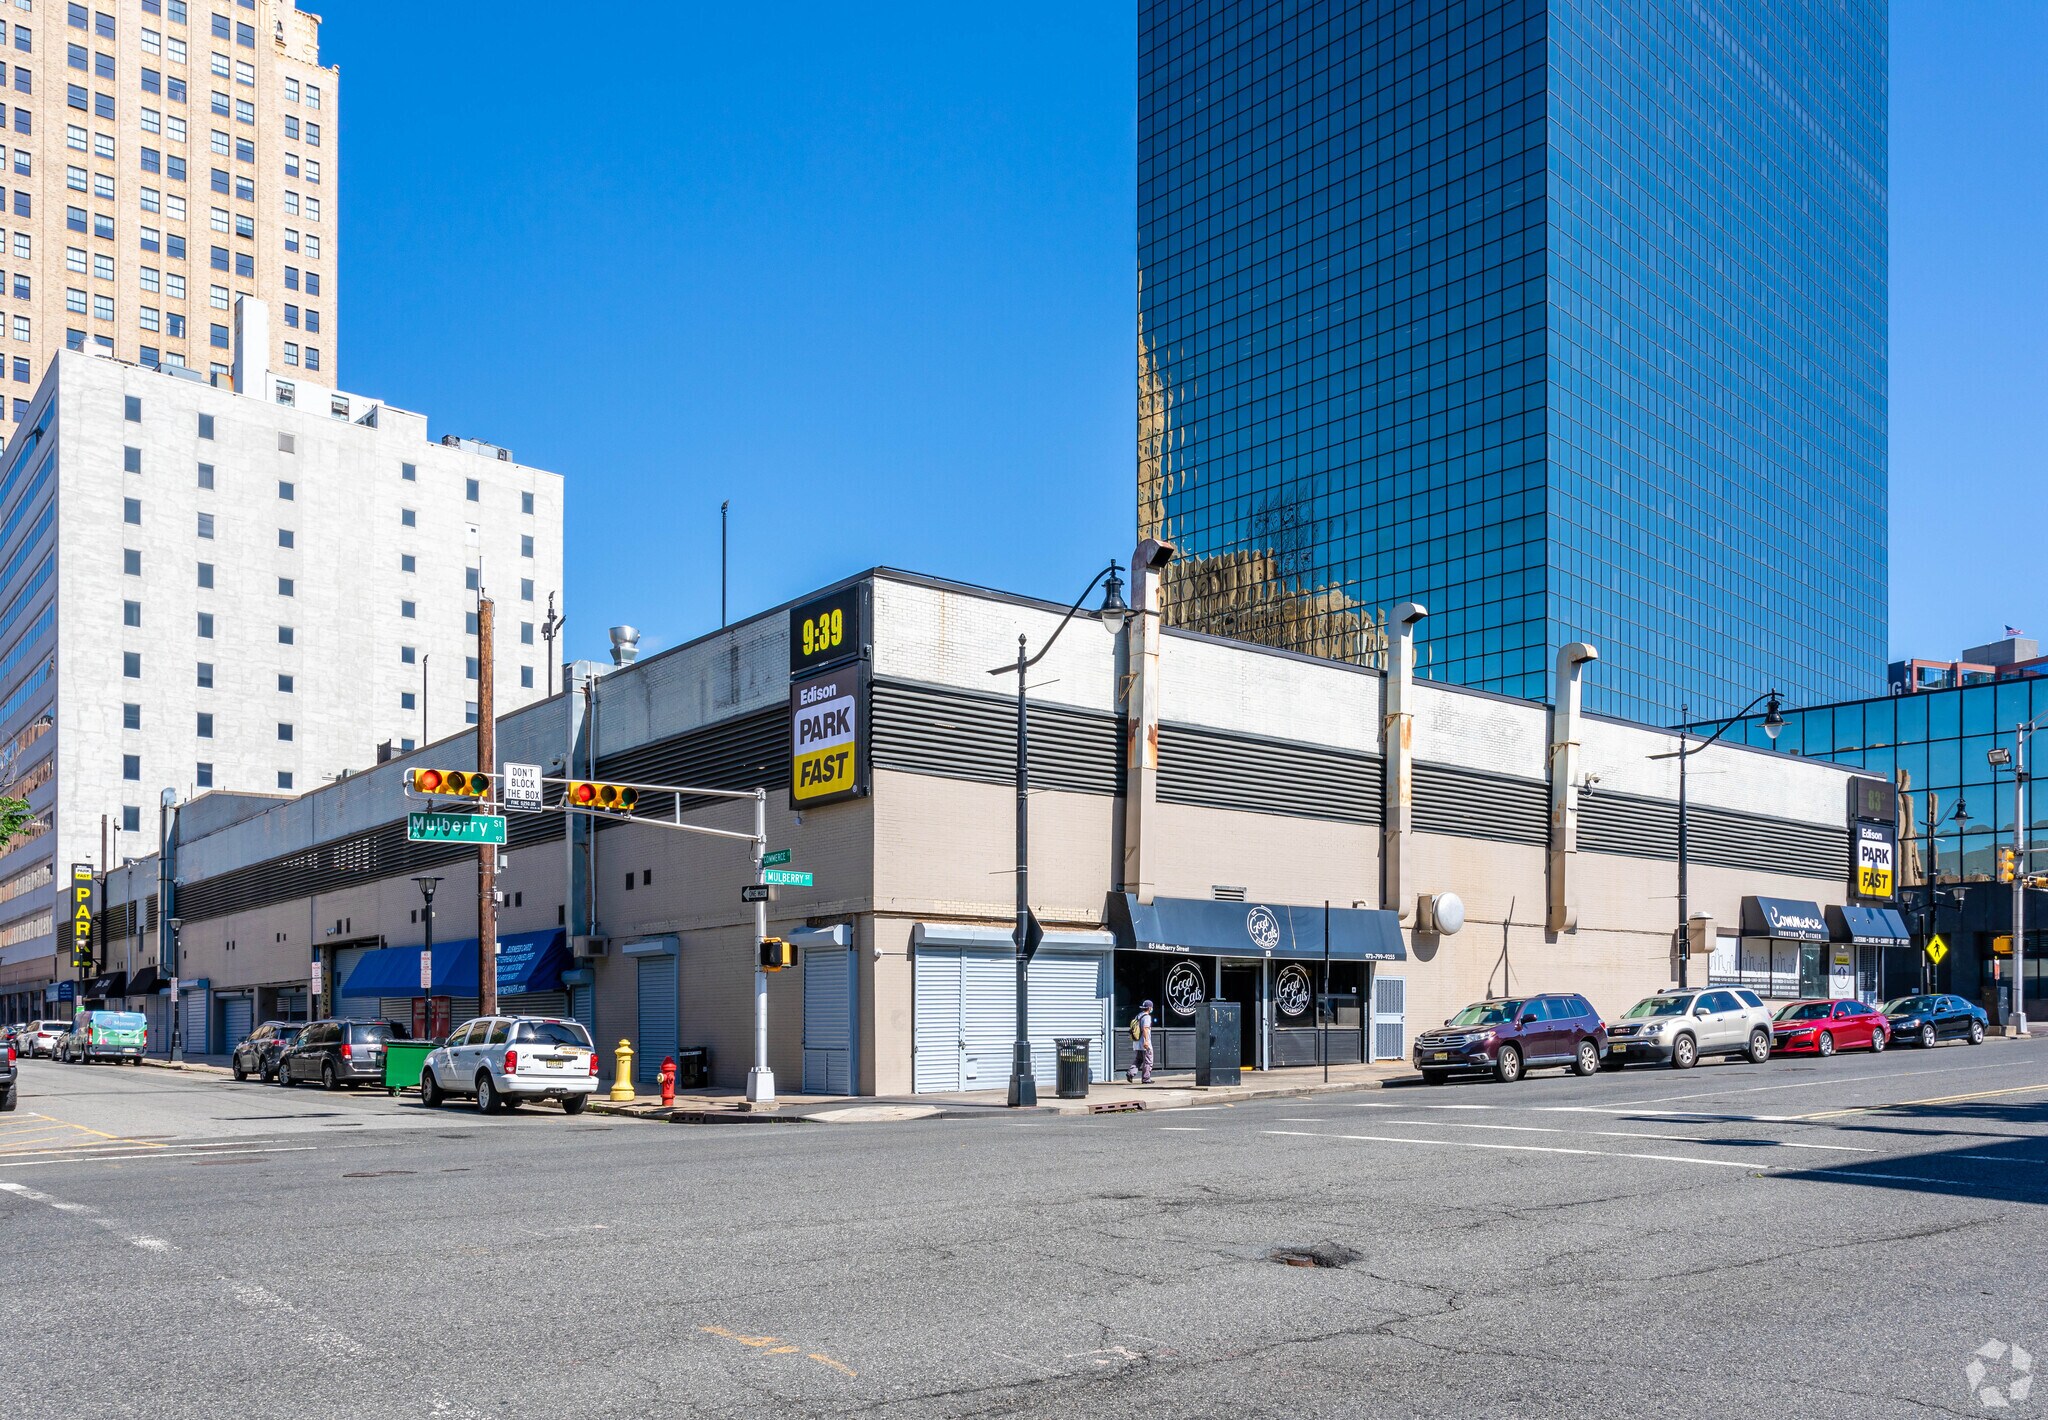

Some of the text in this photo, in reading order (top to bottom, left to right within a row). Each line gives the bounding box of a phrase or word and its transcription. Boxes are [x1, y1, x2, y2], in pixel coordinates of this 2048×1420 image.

[803, 608, 843, 656] 9:39
[800, 683, 837, 706] Edison
[800, 706, 851, 745] PARK
[512, 767, 533, 777] DON'T
[800, 751, 849, 788] FAST
[511, 778, 535, 788] BLOCK
[507, 789, 540, 800] THE BOX
[412, 815, 502, 837] Mulberry St
[1861, 828, 1882, 840] Edison
[764, 852, 786, 864] COMMERCE
[1862, 846, 1889, 864] PARK
[768, 872, 804, 884] MULBERRY
[1863, 872, 1888, 889] FAST
[1250, 915, 1269, 934] Good
[1770, 906, 1822, 930] Commerce
[1262, 928, 1277, 943] Eats
[1156, 943, 1175, 952] Mulberry
[1176, 944, 1189, 952] Street
[1169, 972, 1194, 997] Good
[1279, 975, 1300, 998] Good
[1182, 987, 1202, 1008] Eats
[1290, 988, 1307, 1008] Eats
